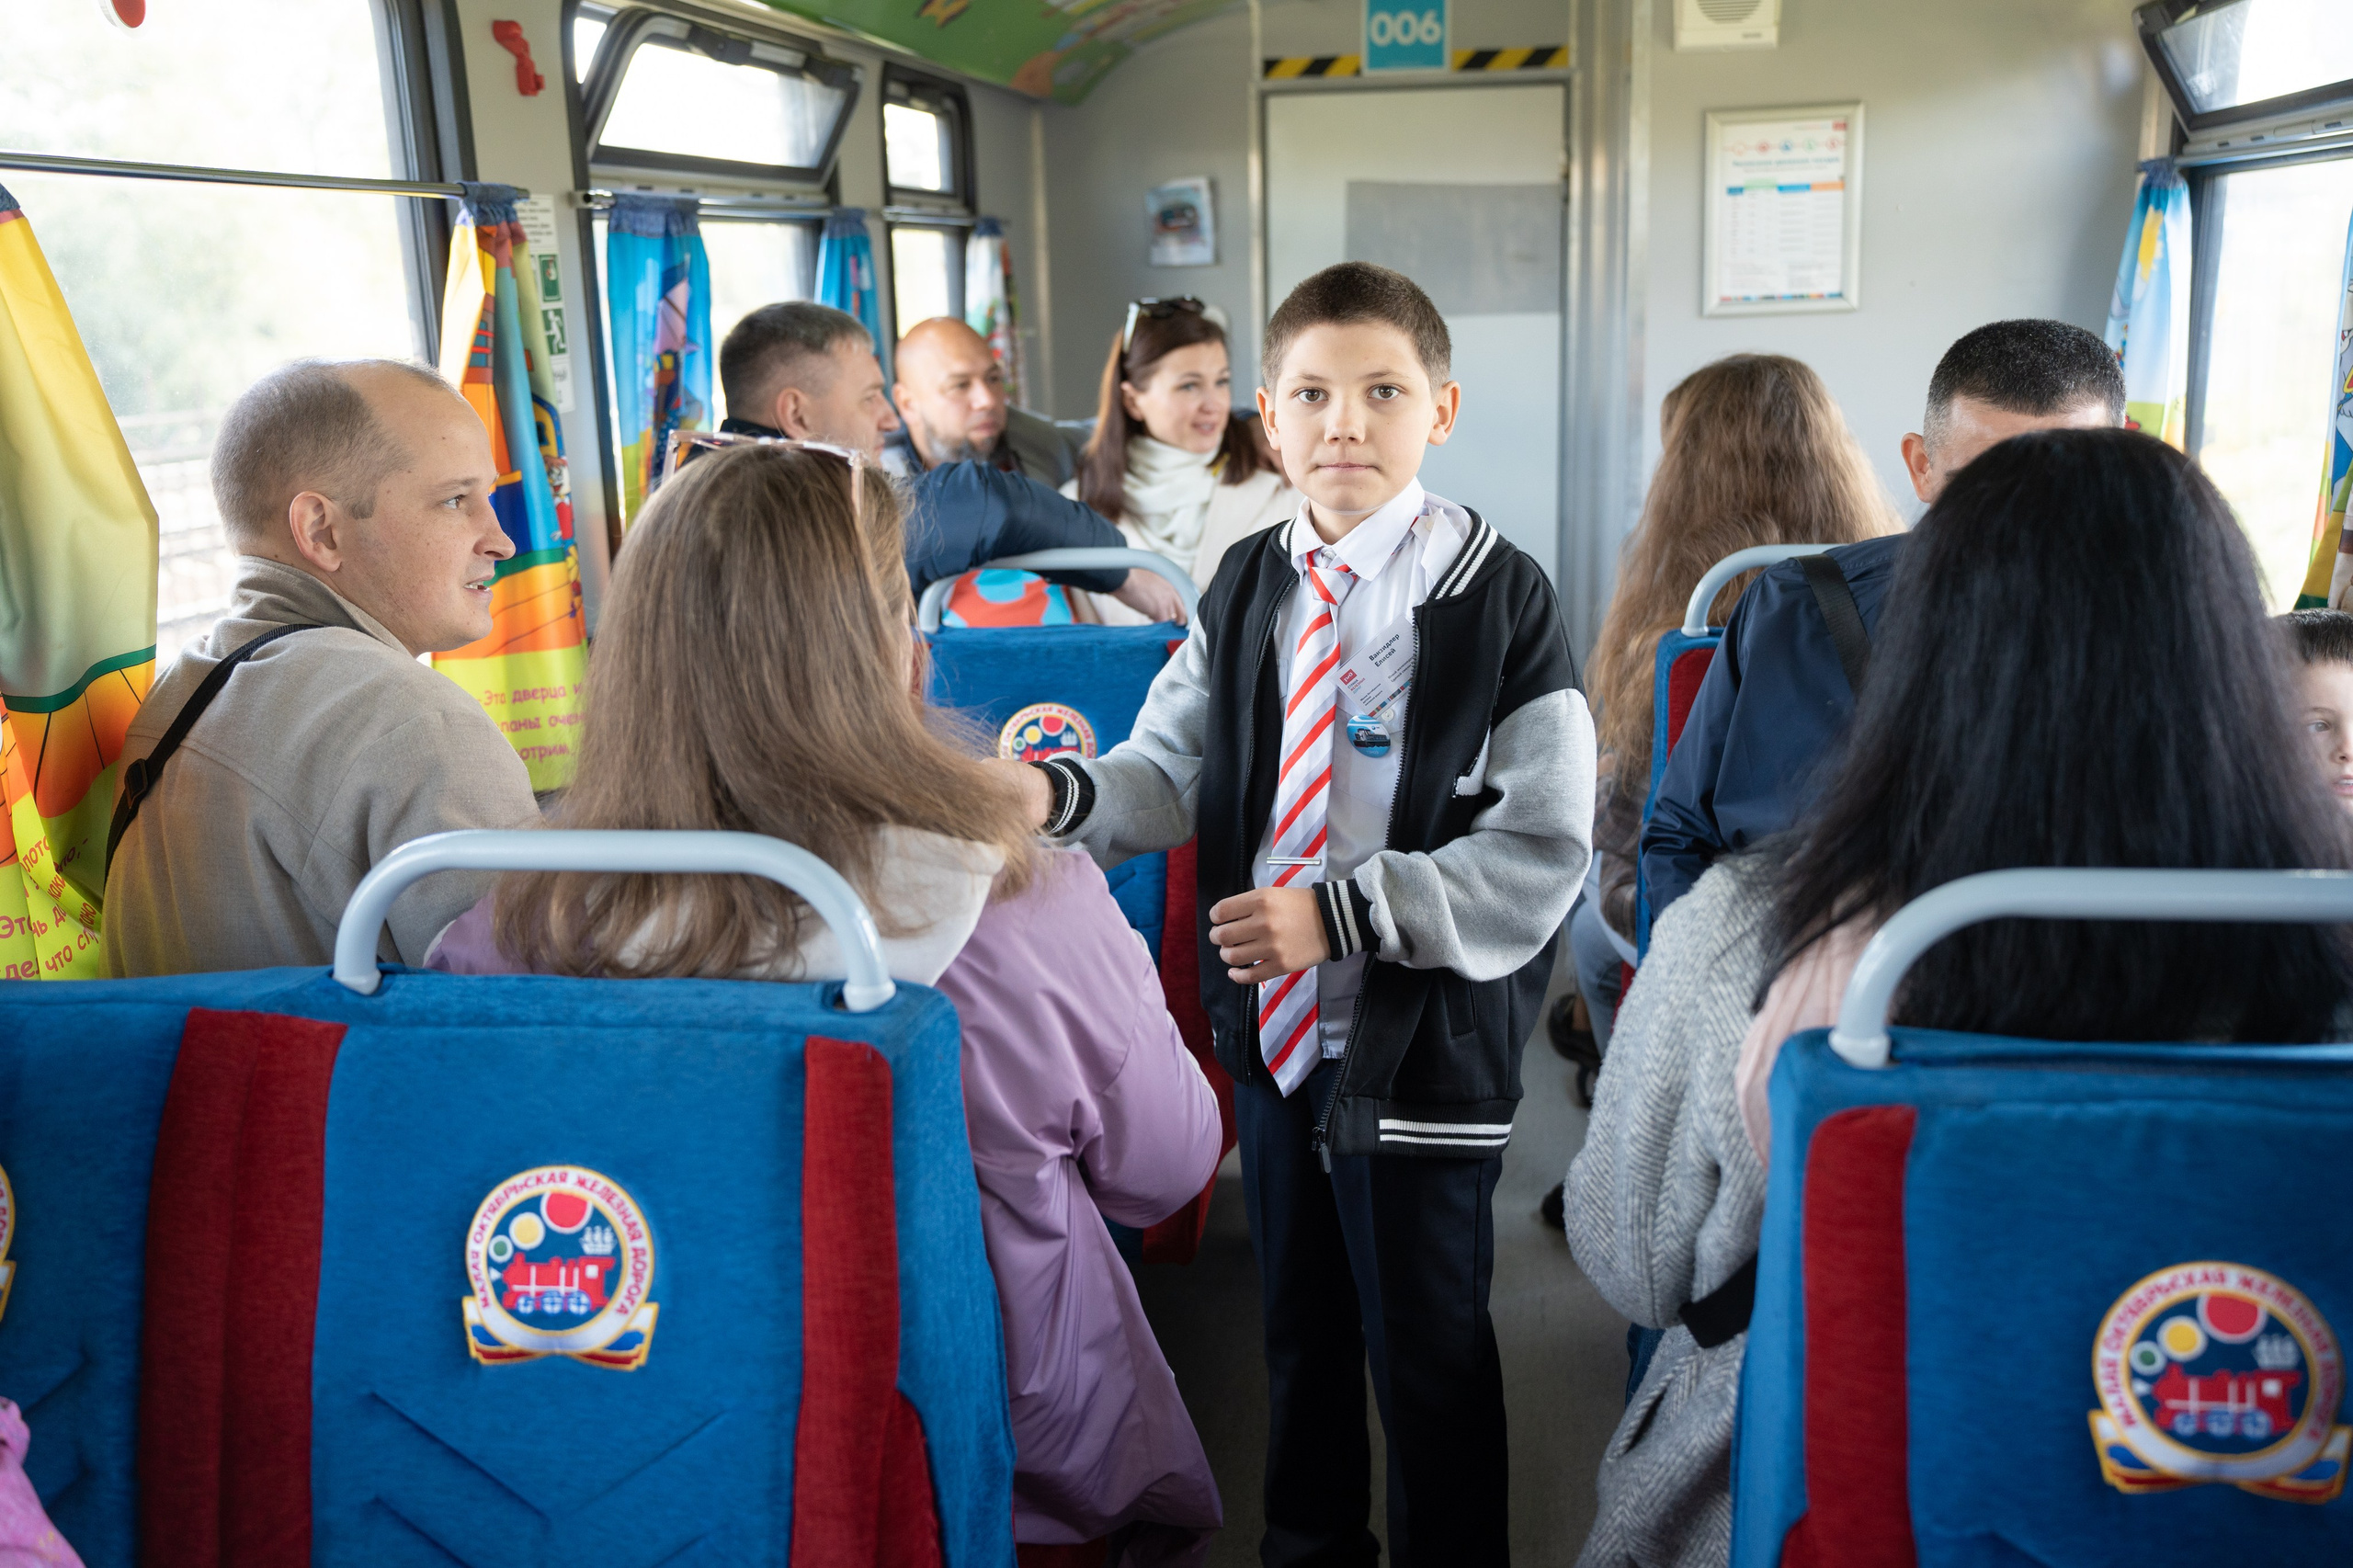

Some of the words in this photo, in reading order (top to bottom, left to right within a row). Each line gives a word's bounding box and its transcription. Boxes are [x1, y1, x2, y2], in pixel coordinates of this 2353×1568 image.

[1370, 10, 1442, 46] 006
[1369, 633, 1400, 662] Ванзидлер
[1374, 648, 1396, 667] Елисей
[511, 686, 566, 704] дверца
[499, 717, 541, 733] паны
[518, 744, 570, 764] отрим
[45, 945, 73, 971] что
[474, 1172, 569, 1244] ОКТЯБРЬСКАЯ
[575, 1175, 642, 1243] ЖЕЛЕЗНАЯ
[615, 1248, 646, 1316] ДОРОГА
